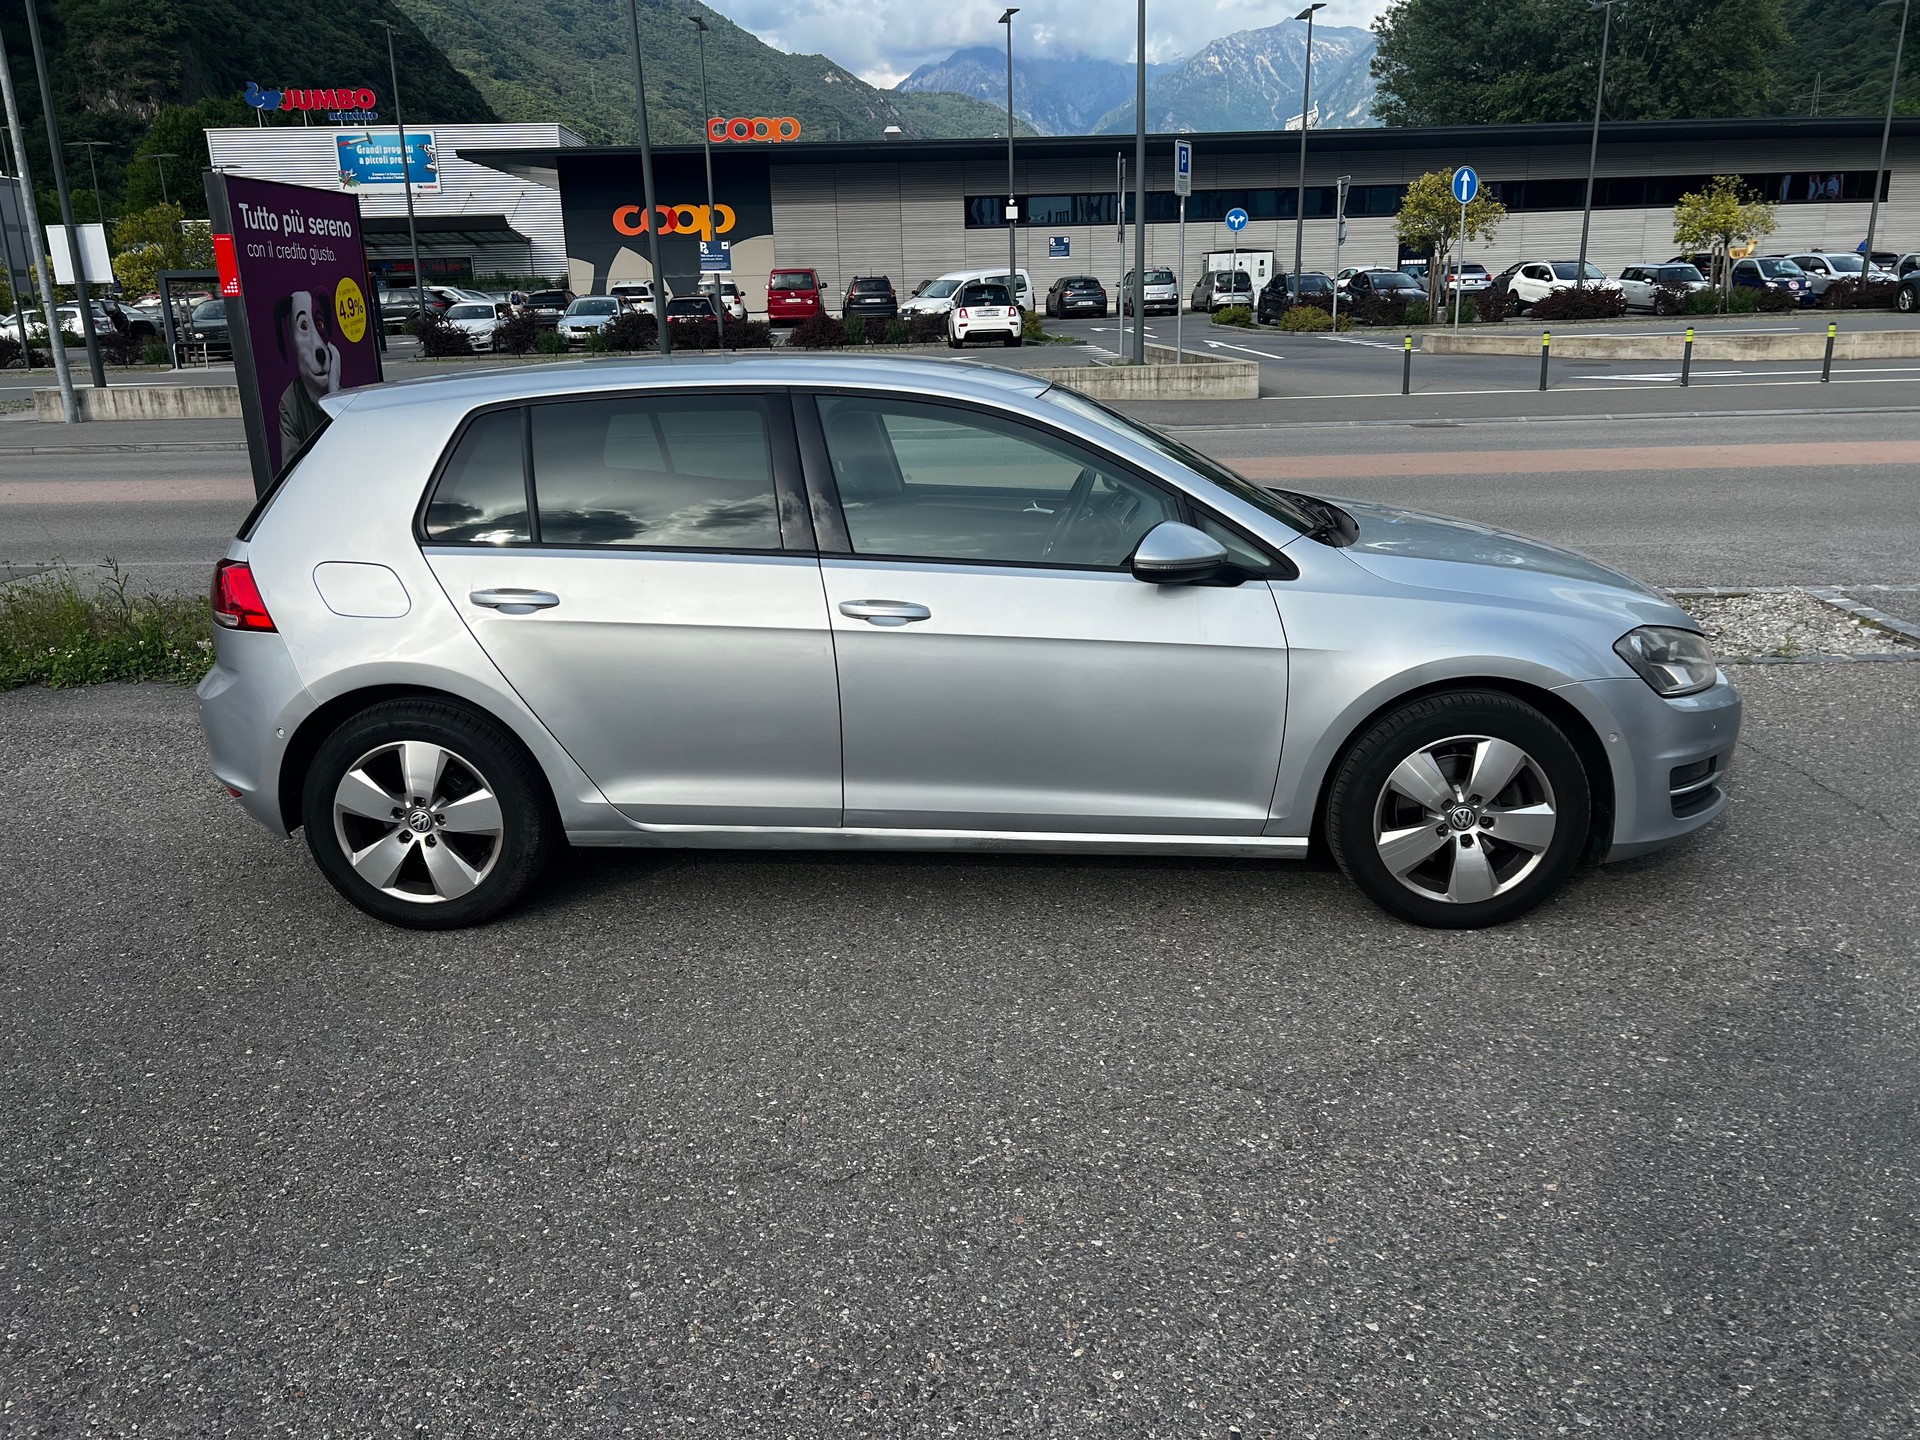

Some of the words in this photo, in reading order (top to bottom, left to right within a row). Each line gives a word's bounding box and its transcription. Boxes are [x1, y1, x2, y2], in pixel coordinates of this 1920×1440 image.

[281, 88, 376, 111] JUMBO
[707, 116, 801, 143] coop
[356, 144, 382, 155] Grandi
[383, 144, 414, 155] progtti
[359, 157, 364, 165] a
[365, 155, 389, 166] piccoli
[389, 154, 415, 165] prezi.
[1181, 150, 1187, 170] P
[238, 202, 279, 232] Tutto
[282, 209, 305, 237] più
[308, 217, 352, 239] sereno
[612, 203, 736, 242] coop
[247, 242, 266, 258] con
[267, 240, 274, 258] il
[276, 241, 307, 261] credito
[309, 244, 337, 266] giusto.
[339, 297, 364, 320] 4.9%
